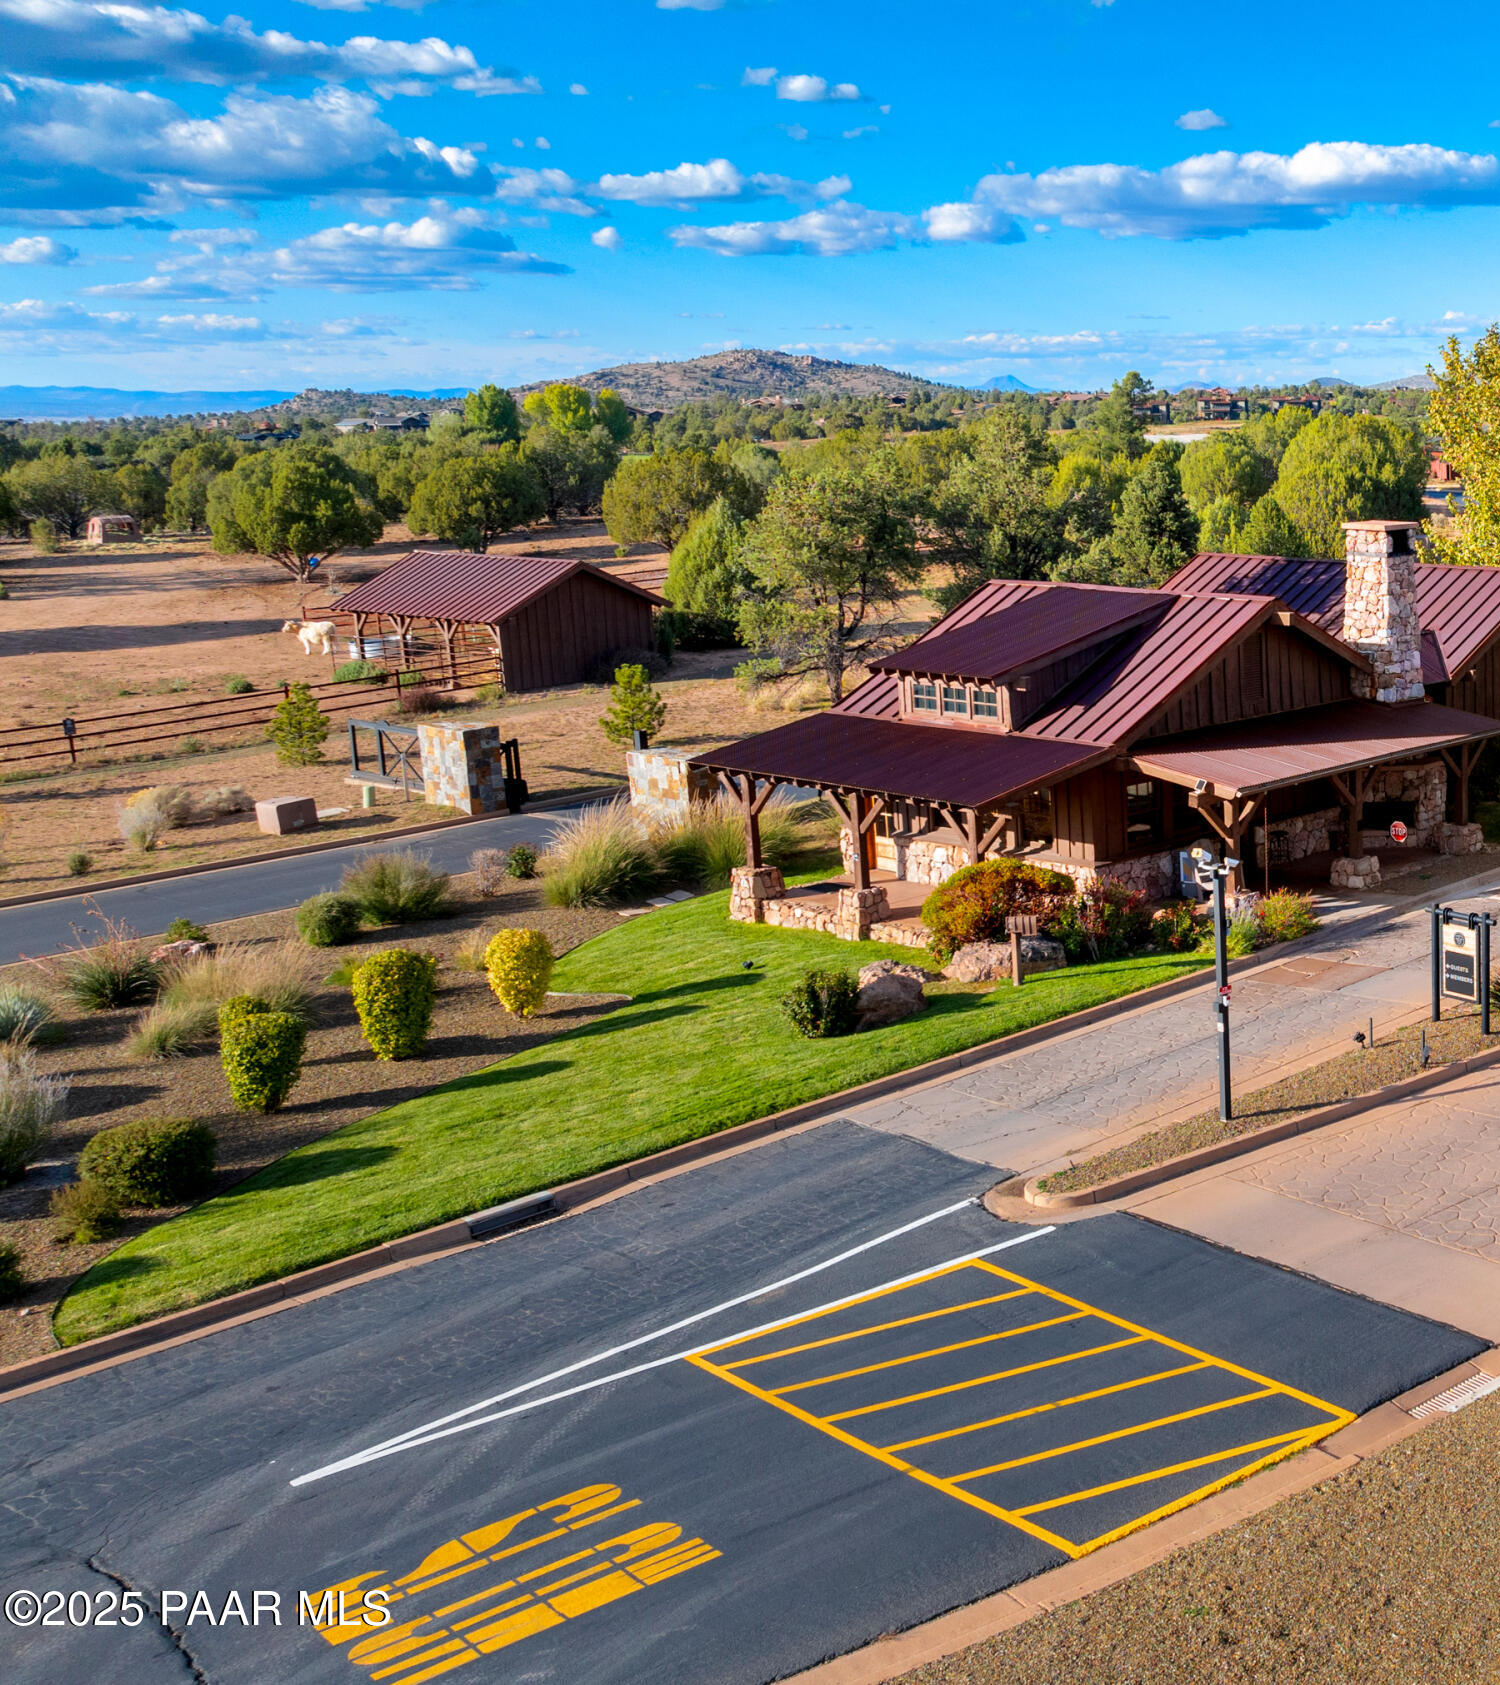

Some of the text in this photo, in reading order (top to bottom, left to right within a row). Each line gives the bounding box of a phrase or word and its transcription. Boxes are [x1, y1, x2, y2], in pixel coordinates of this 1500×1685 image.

[1391, 827, 1407, 836] STOP
[1450, 964, 1469, 973] GUESTS
[1450, 974, 1473, 984] MEMBERS
[296, 1483, 723, 1685] SLOW
